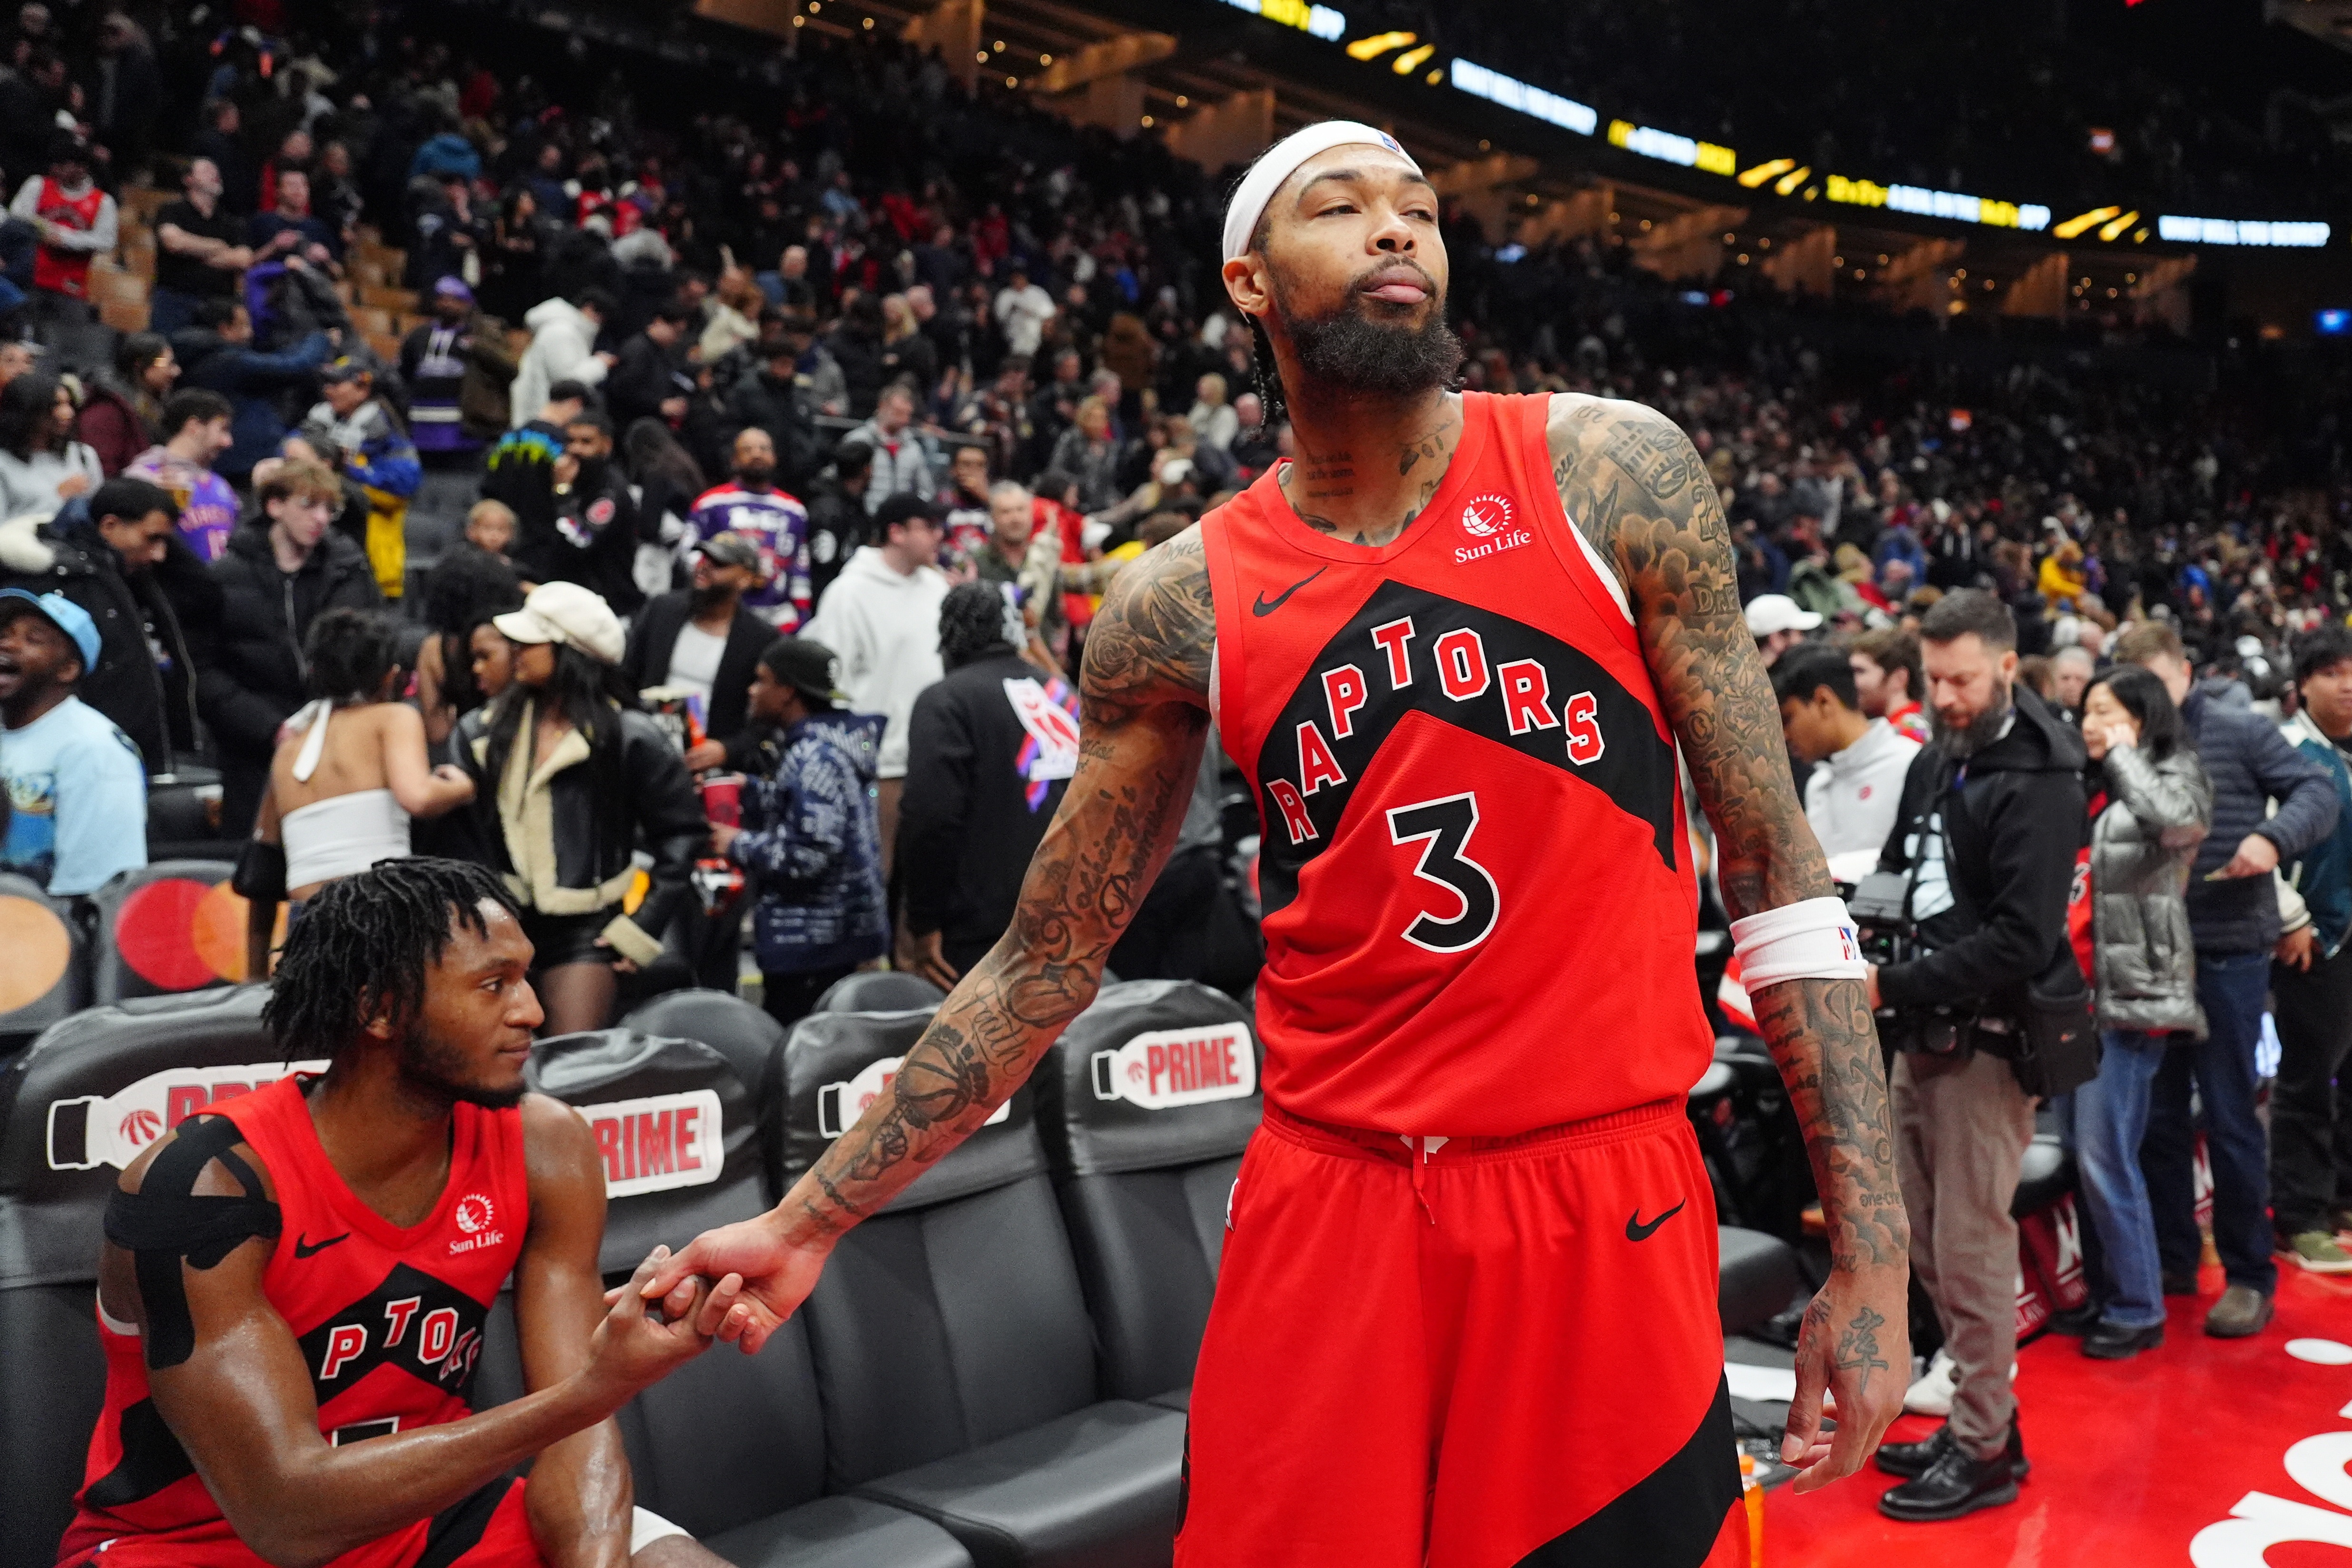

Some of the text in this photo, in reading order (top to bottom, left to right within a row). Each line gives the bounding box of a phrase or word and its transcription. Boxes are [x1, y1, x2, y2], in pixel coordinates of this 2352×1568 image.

[1455, 529, 1531, 563] Sun Life
[1266, 616, 1605, 845] RAPTORS
[1385, 791, 1500, 953] 3
[950, 976, 1037, 1077] Faith
[1147, 1037, 1239, 1096] PRIME
[592, 1107, 701, 1182] RIME
[449, 1229, 504, 1255] Sun Life
